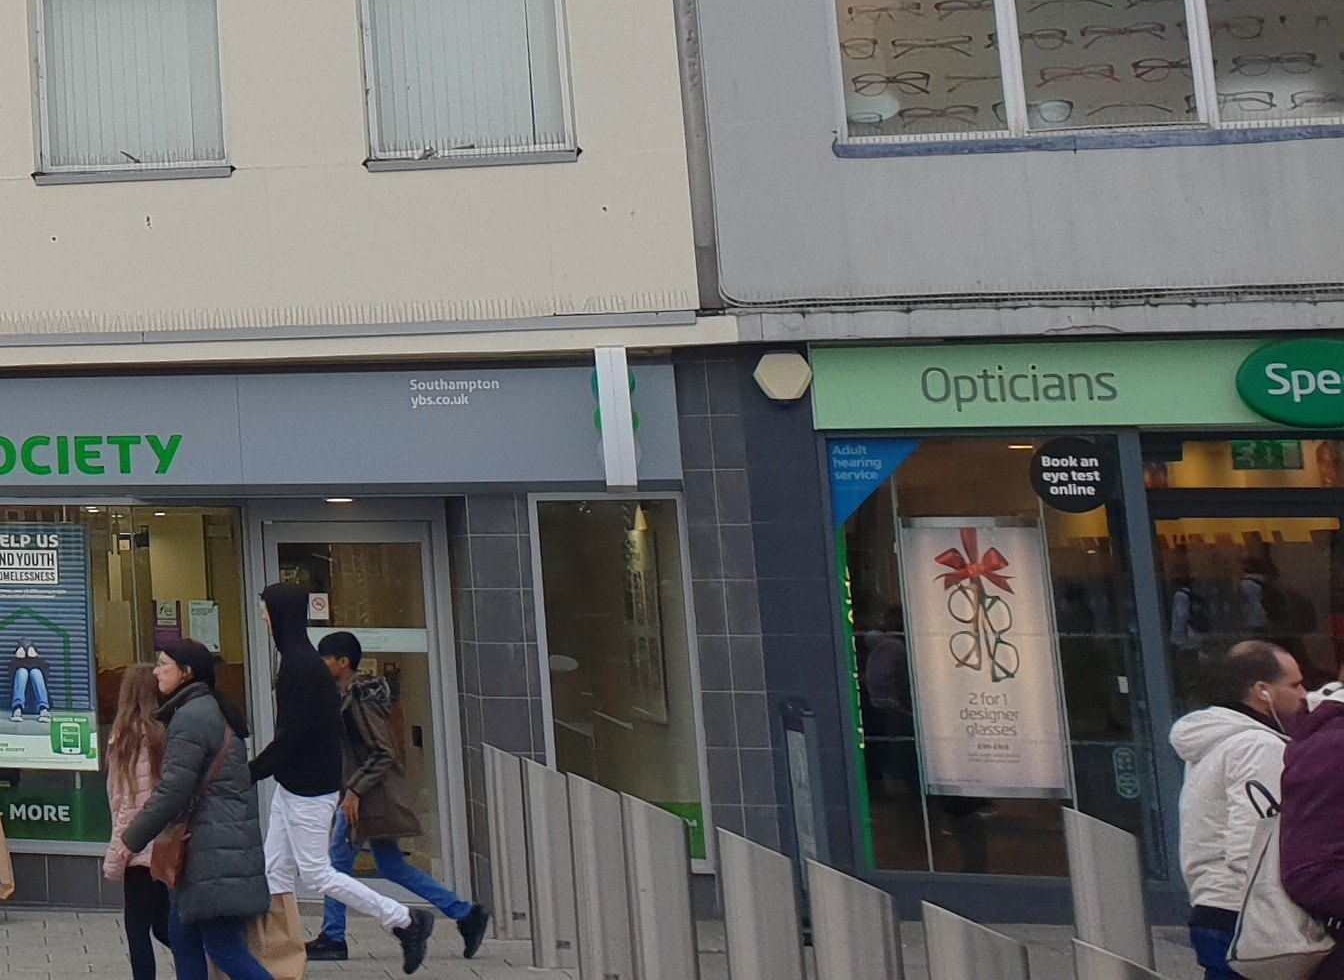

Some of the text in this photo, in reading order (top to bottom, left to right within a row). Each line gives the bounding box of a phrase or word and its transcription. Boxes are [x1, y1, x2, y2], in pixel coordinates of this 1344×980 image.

[410, 378, 499, 392] Southampton
[921, 364, 1118, 412] Opticians
[1265, 363, 1344, 403] Spe
[411, 394, 469, 409] ybs.co.uk
[832, 445, 867, 455] Adult
[832, 456, 882, 469] hearing
[1041, 455, 1099, 467] Book an
[834, 470, 879, 480] service
[1042, 470, 1101, 483] eye test
[1049, 484, 1096, 495] online
[36, 534, 59, 548] US
[16, 553, 54, 566] YOUTH
[968, 692, 978, 705] 2
[980, 692, 1000, 705] for
[959, 707, 1020, 723] designer
[966, 723, 1017, 738] glasses
[9, 804, 71, 822] MORE
